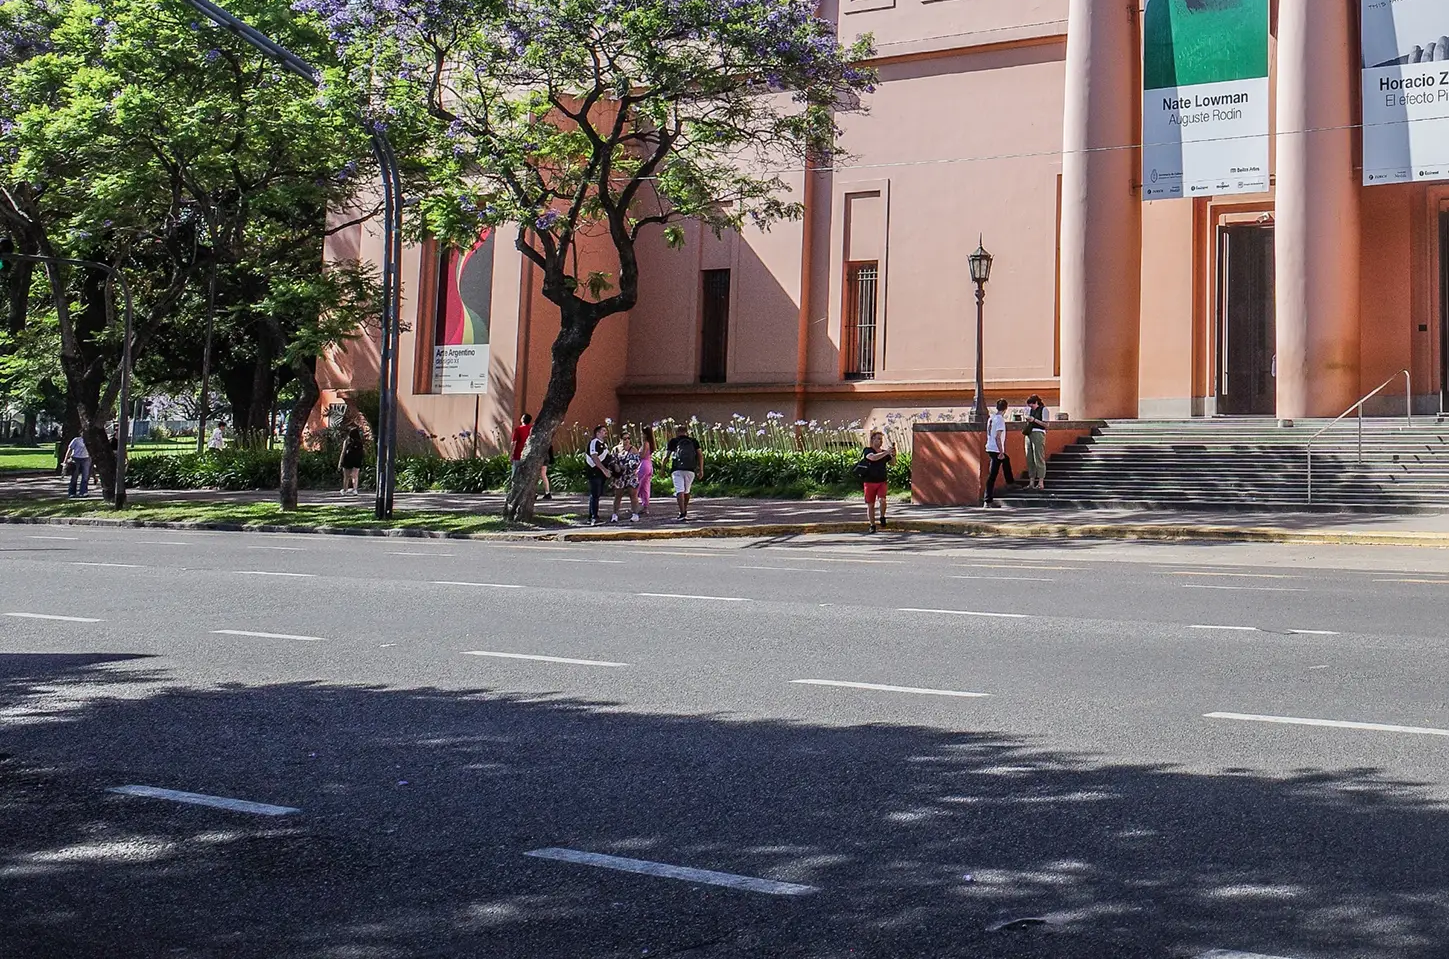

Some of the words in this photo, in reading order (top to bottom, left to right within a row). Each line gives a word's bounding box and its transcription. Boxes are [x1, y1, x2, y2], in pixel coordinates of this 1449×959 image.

[1379, 73, 1435, 91] Horacio
[1162, 97, 1191, 111] Nate
[1195, 92, 1248, 107] Lowman
[1385, 94, 1396, 107] El
[1399, 91, 1434, 105] efecto
[1168, 111, 1210, 127] Auguste
[1213, 107, 1242, 121] Rodin
